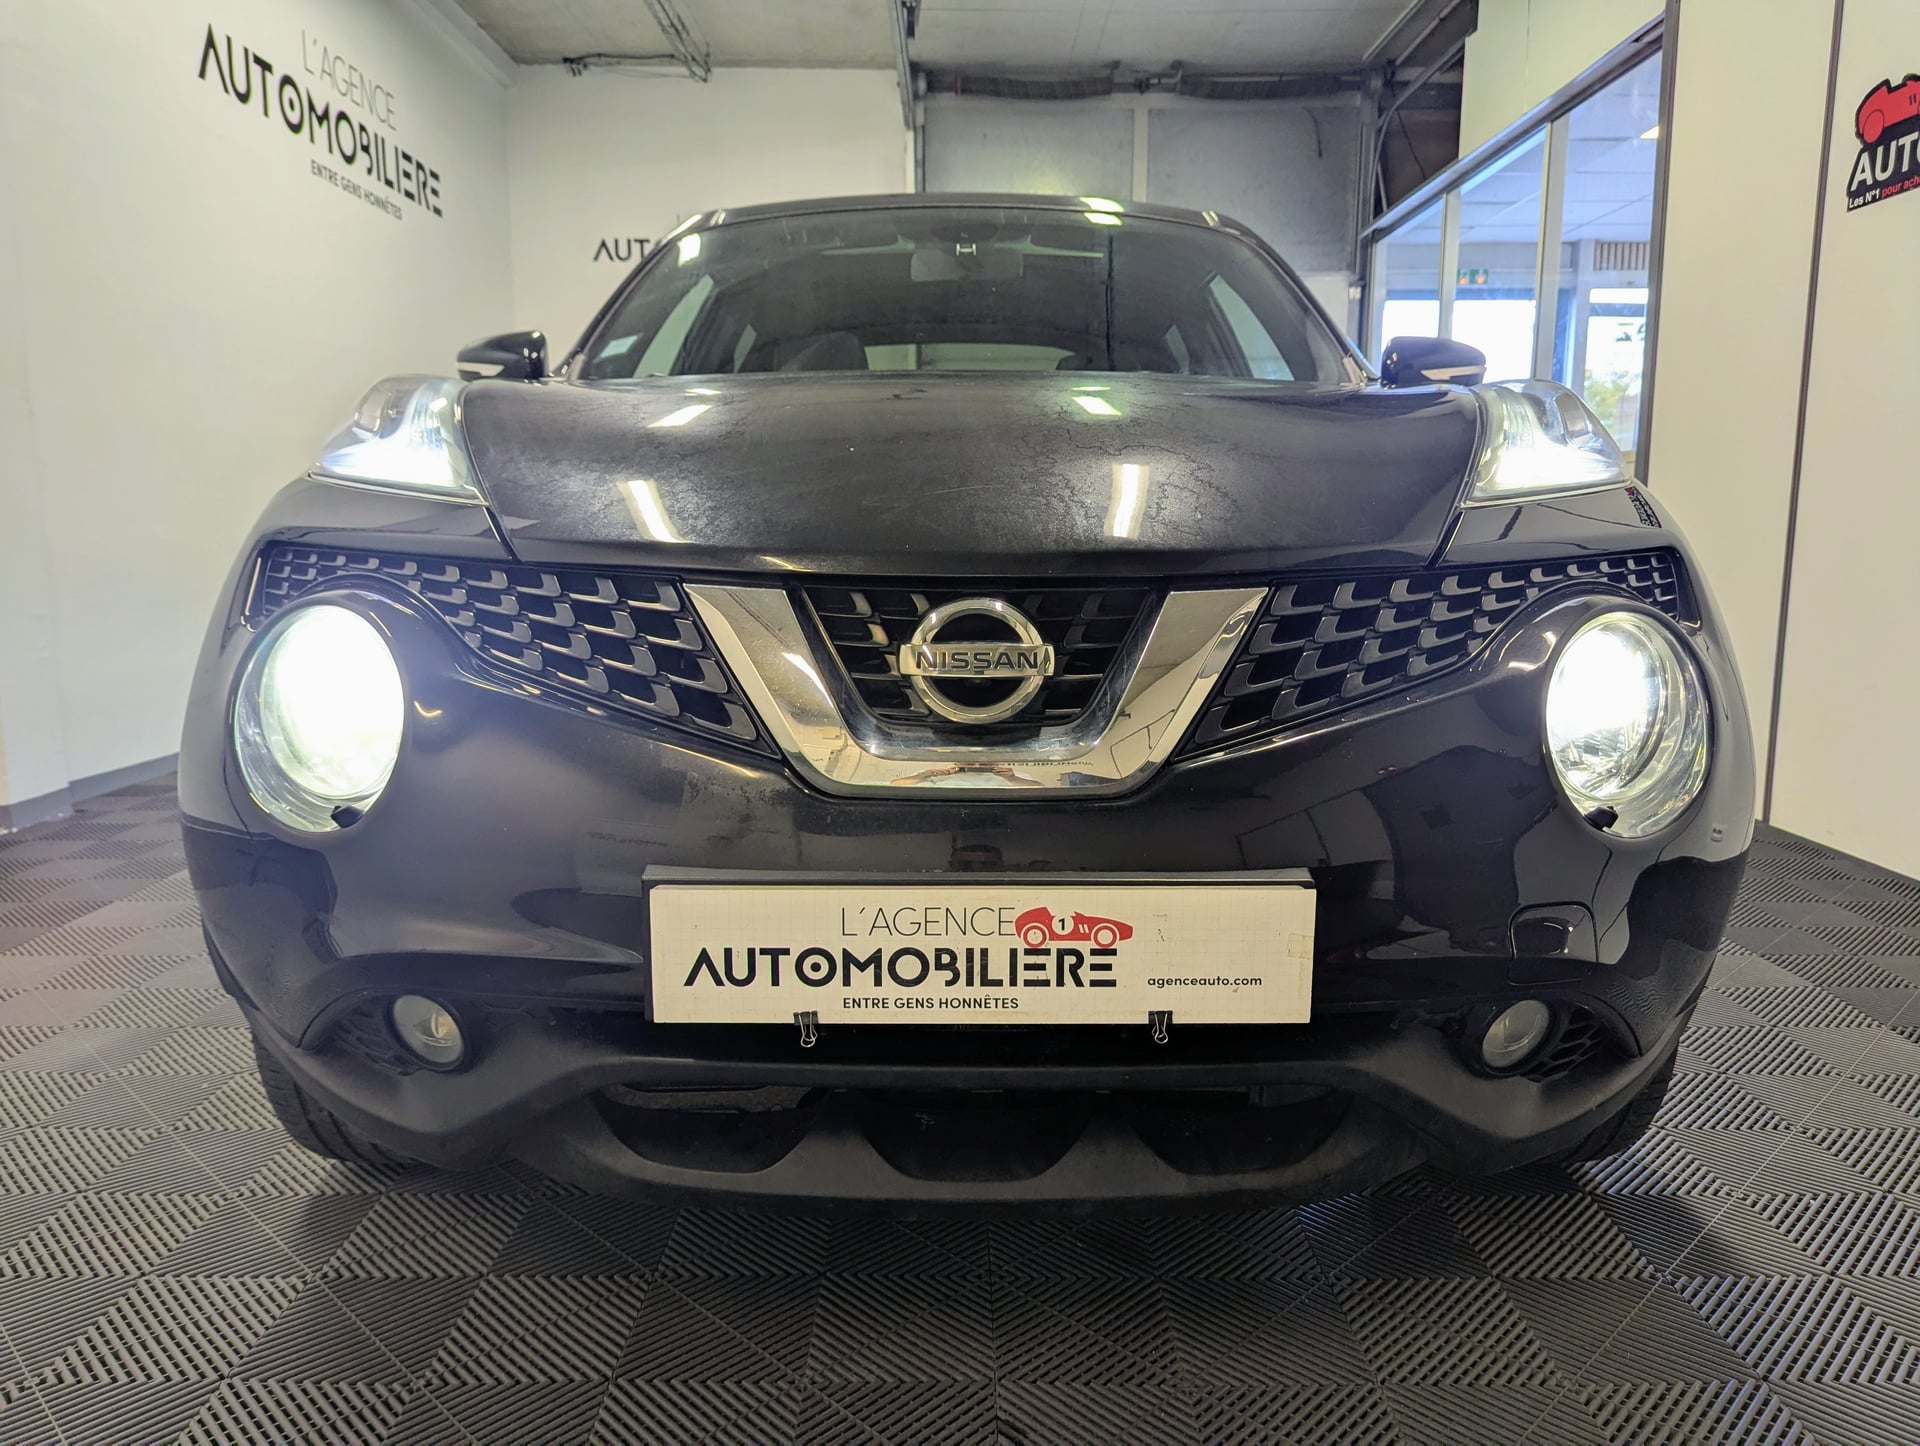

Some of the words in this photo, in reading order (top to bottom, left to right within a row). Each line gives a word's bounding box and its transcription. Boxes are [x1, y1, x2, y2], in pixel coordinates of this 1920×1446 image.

[302, 29, 397, 131] L'AGENCE
[198, 23, 443, 218] AUTOMOBILIERE
[311, 159, 339, 187] ENTRE
[1850, 132, 1920, 192] AUT
[1849, 197, 1864, 209] Les
[1881, 182, 1902, 200] pour
[915, 651, 1038, 670] NISSAN
[842, 907, 1016, 936] L'AGENCE
[1057, 918, 1067, 932] 1
[683, 947, 1118, 988] AUTOMOBILIERE
[1147, 975, 1262, 989] agenceauto.com
[843, 997, 890, 1009] ENTRE
[894, 997, 934, 1009] GENS
[939, 994, 1019, 1009] HONNÊTES
